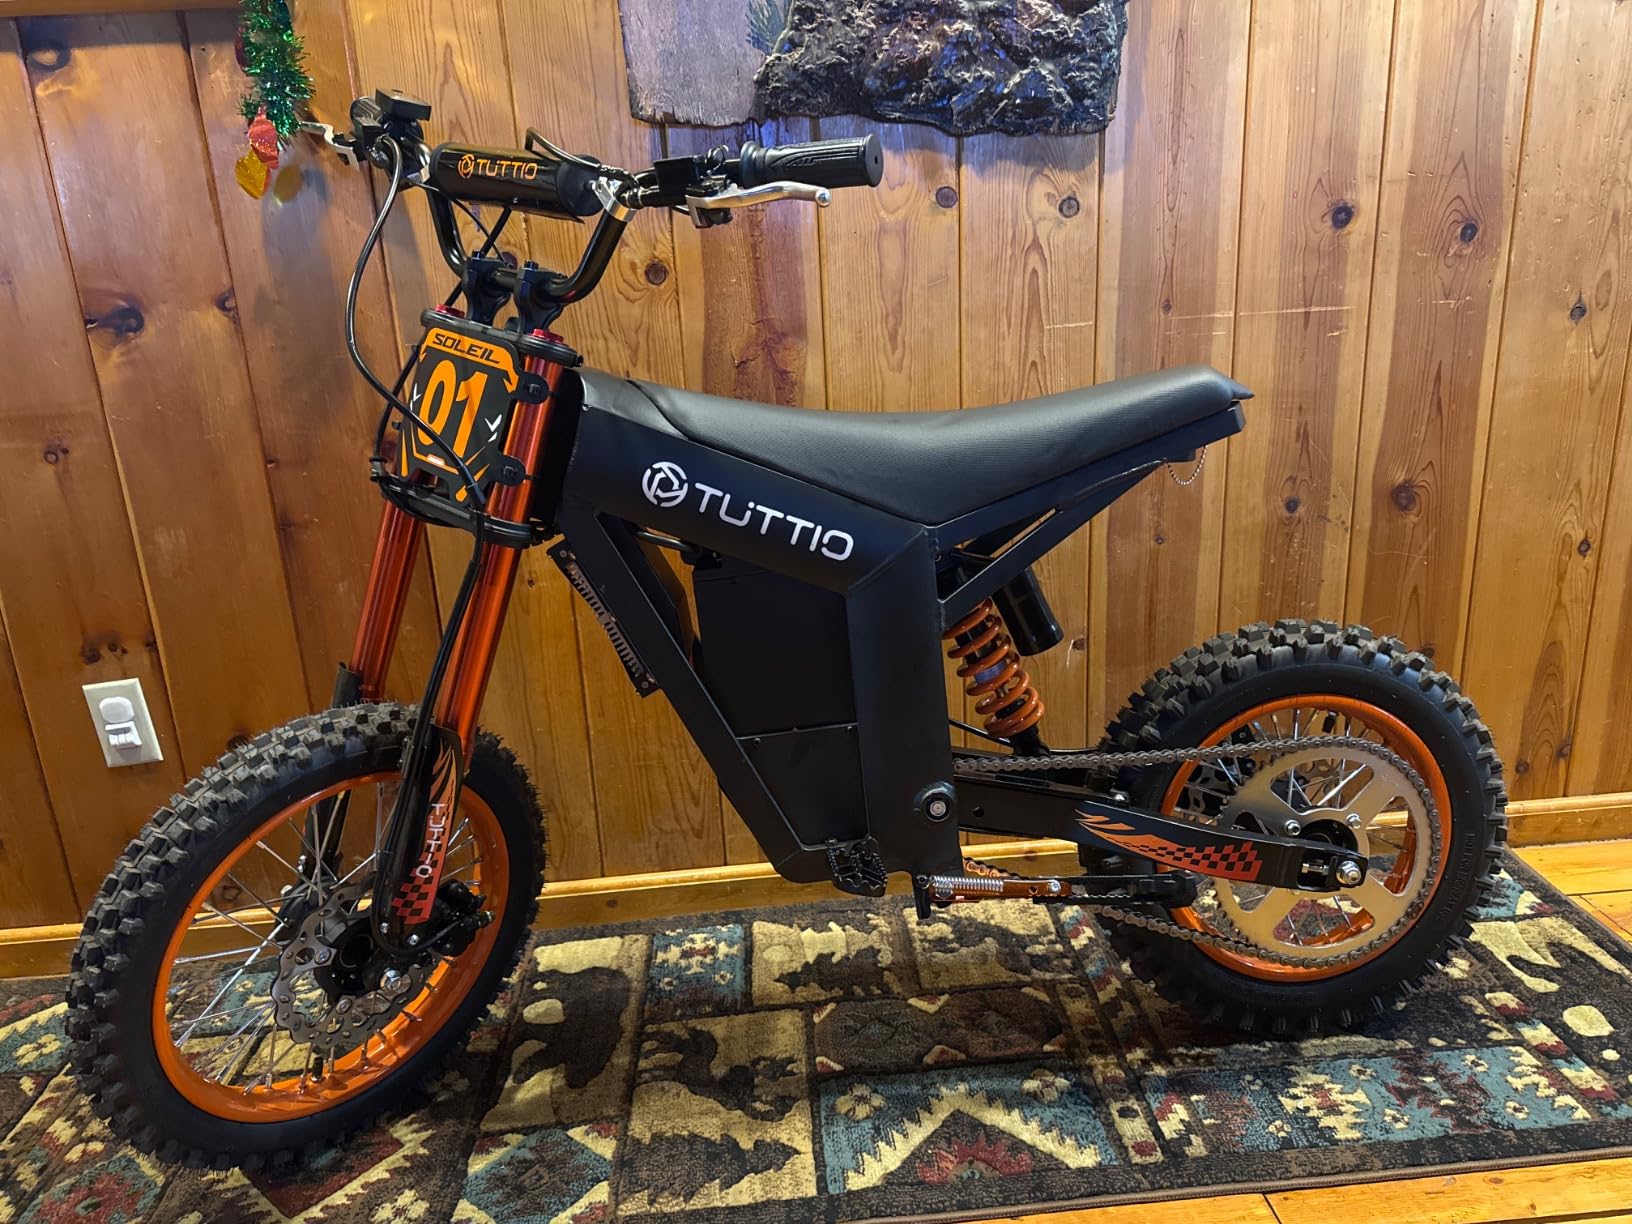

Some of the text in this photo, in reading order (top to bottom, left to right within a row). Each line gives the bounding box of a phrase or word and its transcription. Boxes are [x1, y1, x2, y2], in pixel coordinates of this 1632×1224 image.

[476, 158, 538, 180] TUTTIO
[432, 333, 500, 364] SOLEIL
[417, 359, 488, 458] 01
[695, 482, 854, 561] TUTTIO
[415, 803, 446, 879] TUTTIO
